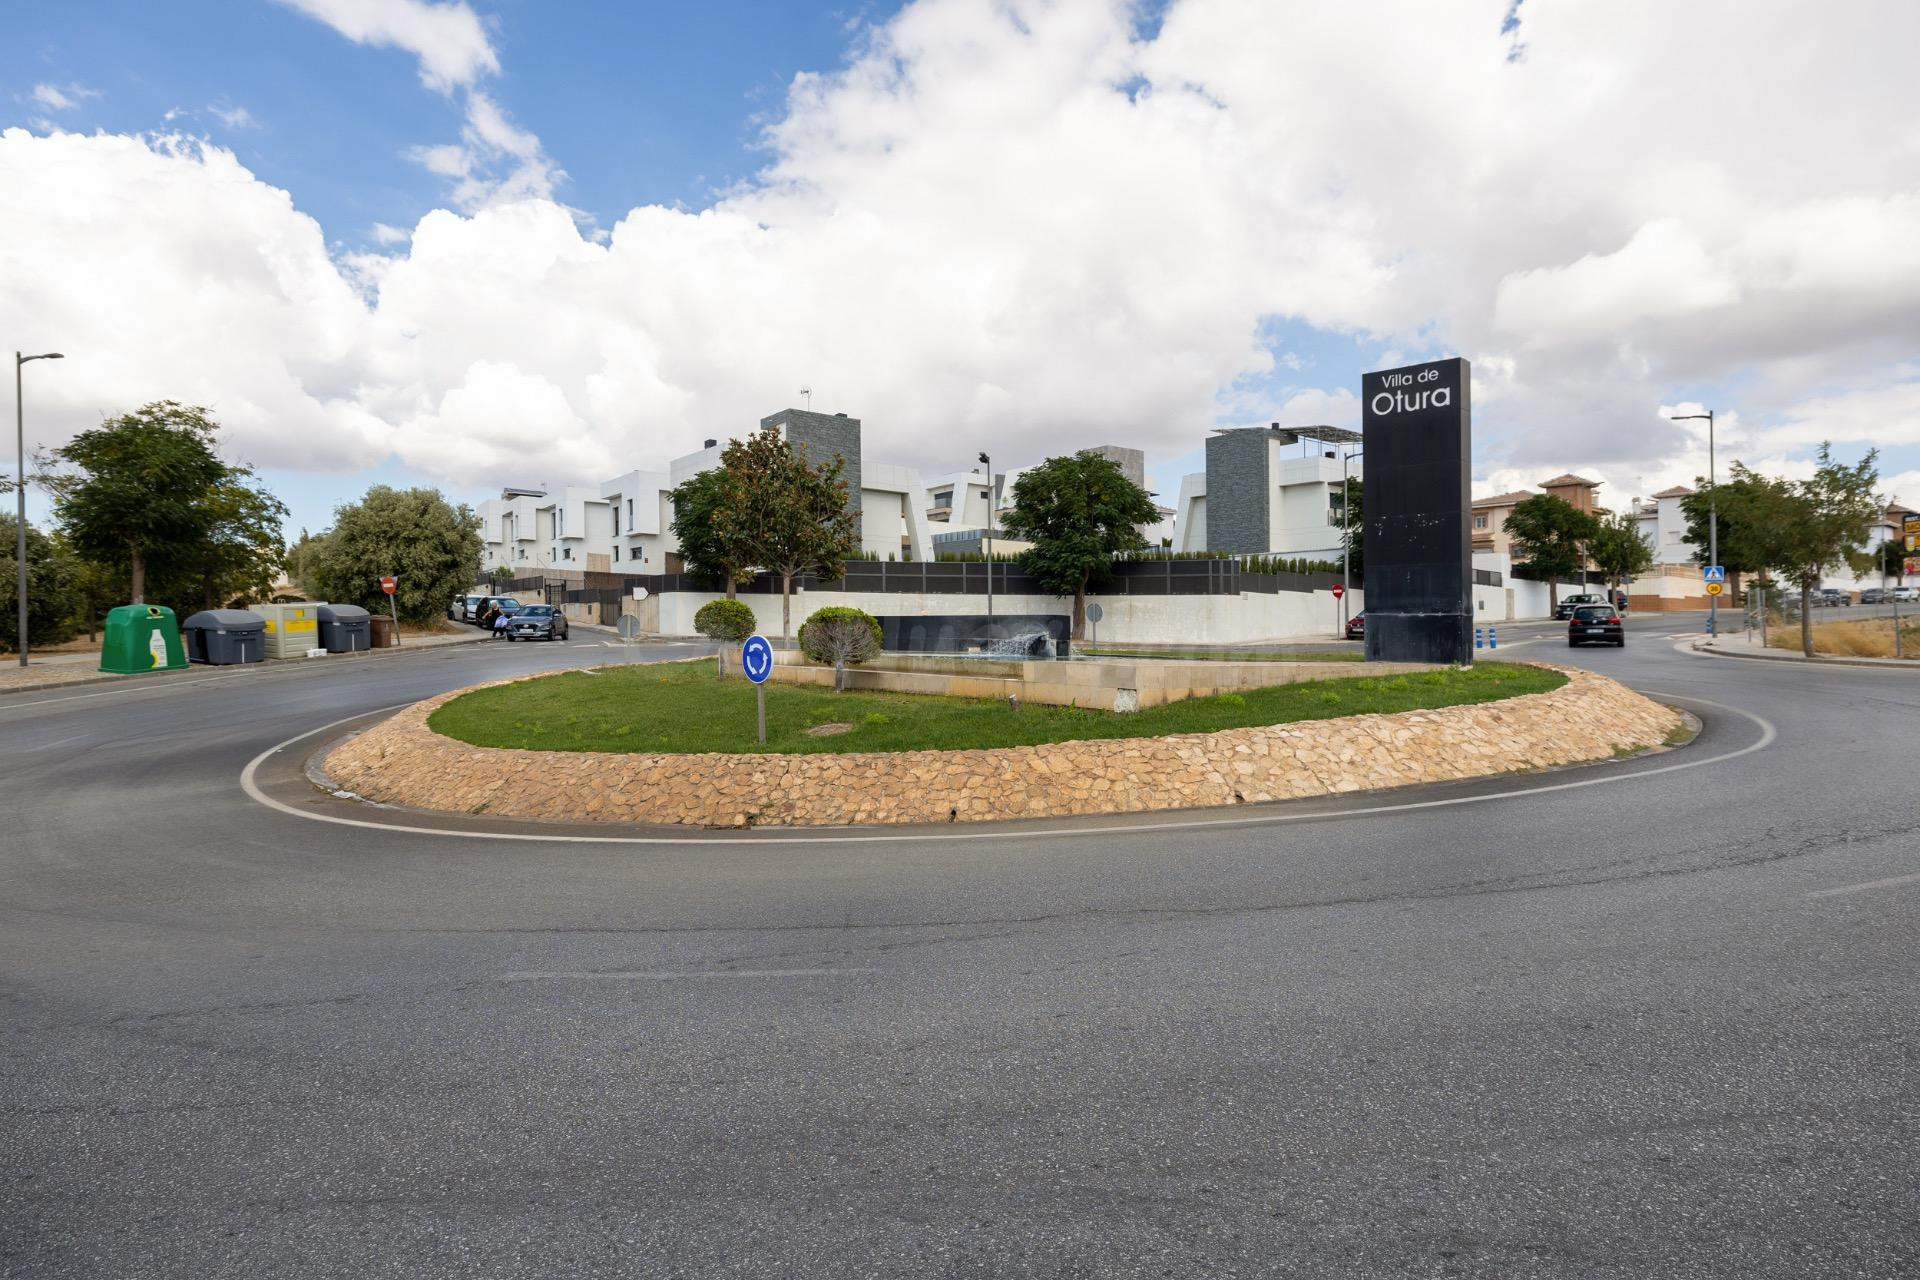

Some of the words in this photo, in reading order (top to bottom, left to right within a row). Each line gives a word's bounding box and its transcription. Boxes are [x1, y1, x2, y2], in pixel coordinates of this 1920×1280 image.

[1381, 373, 1413, 389] Villa
[1417, 369, 1439, 383] de
[1371, 387, 1451, 415] Otura
